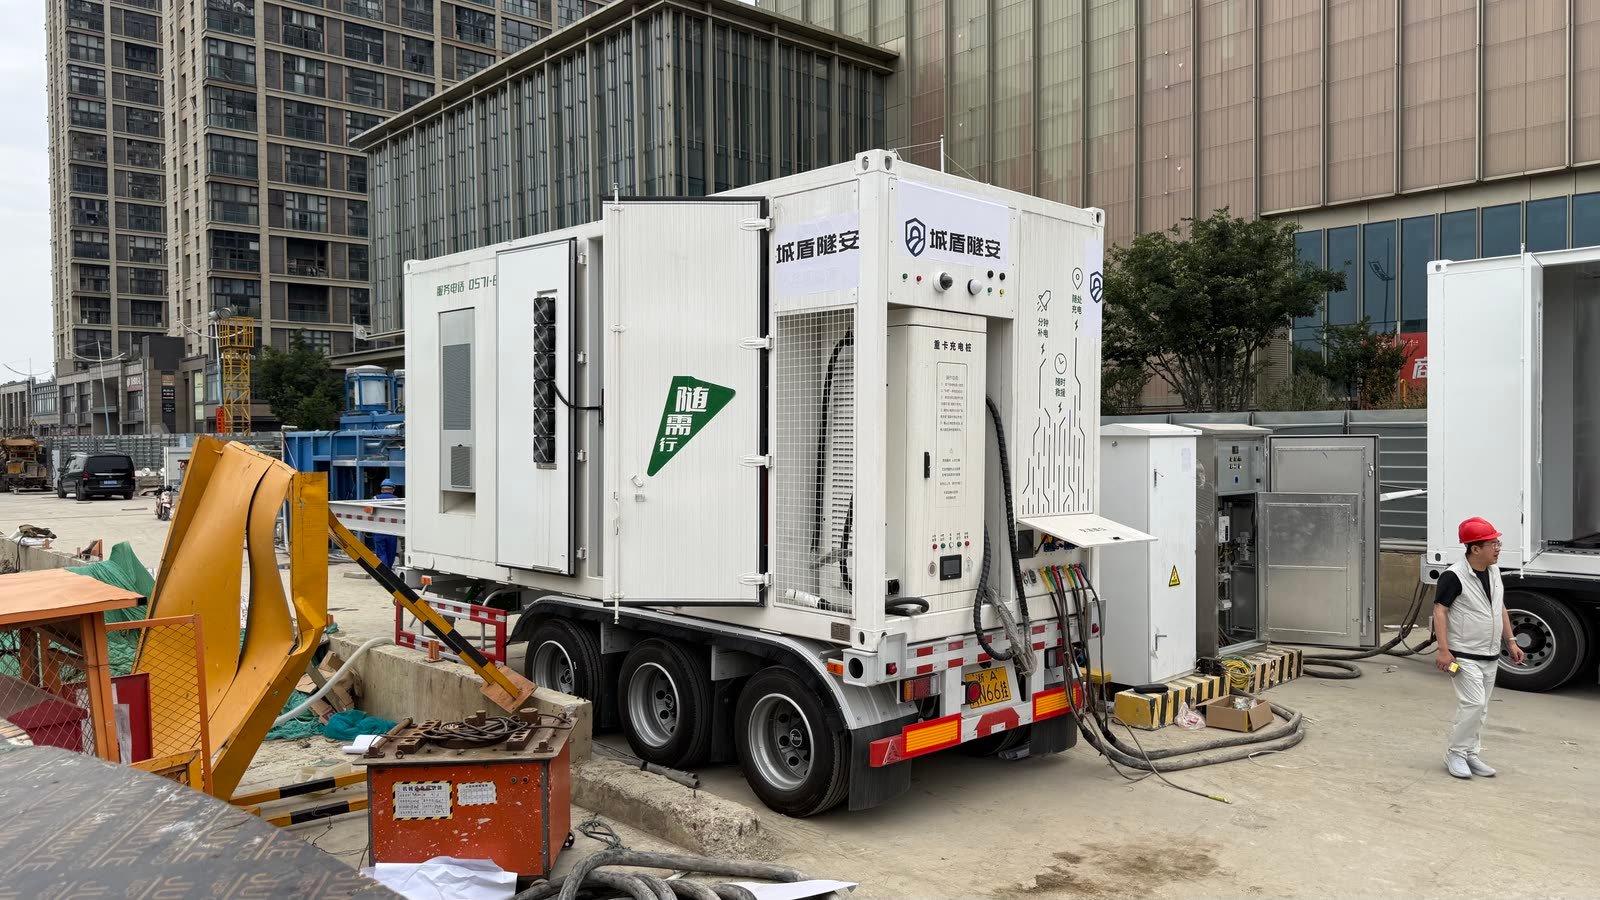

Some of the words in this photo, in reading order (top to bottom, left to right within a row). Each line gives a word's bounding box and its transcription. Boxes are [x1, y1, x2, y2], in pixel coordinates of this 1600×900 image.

[776, 230, 860, 264] 城盾隧安
[929, 228, 1001, 260] 城盾隧安
[436, 281, 465, 297] 服务电话
[1072, 305, 1083, 315] 充电
[1038, 317, 1049, 328] 分钟
[933, 339, 972, 353] 重卡充电桩
